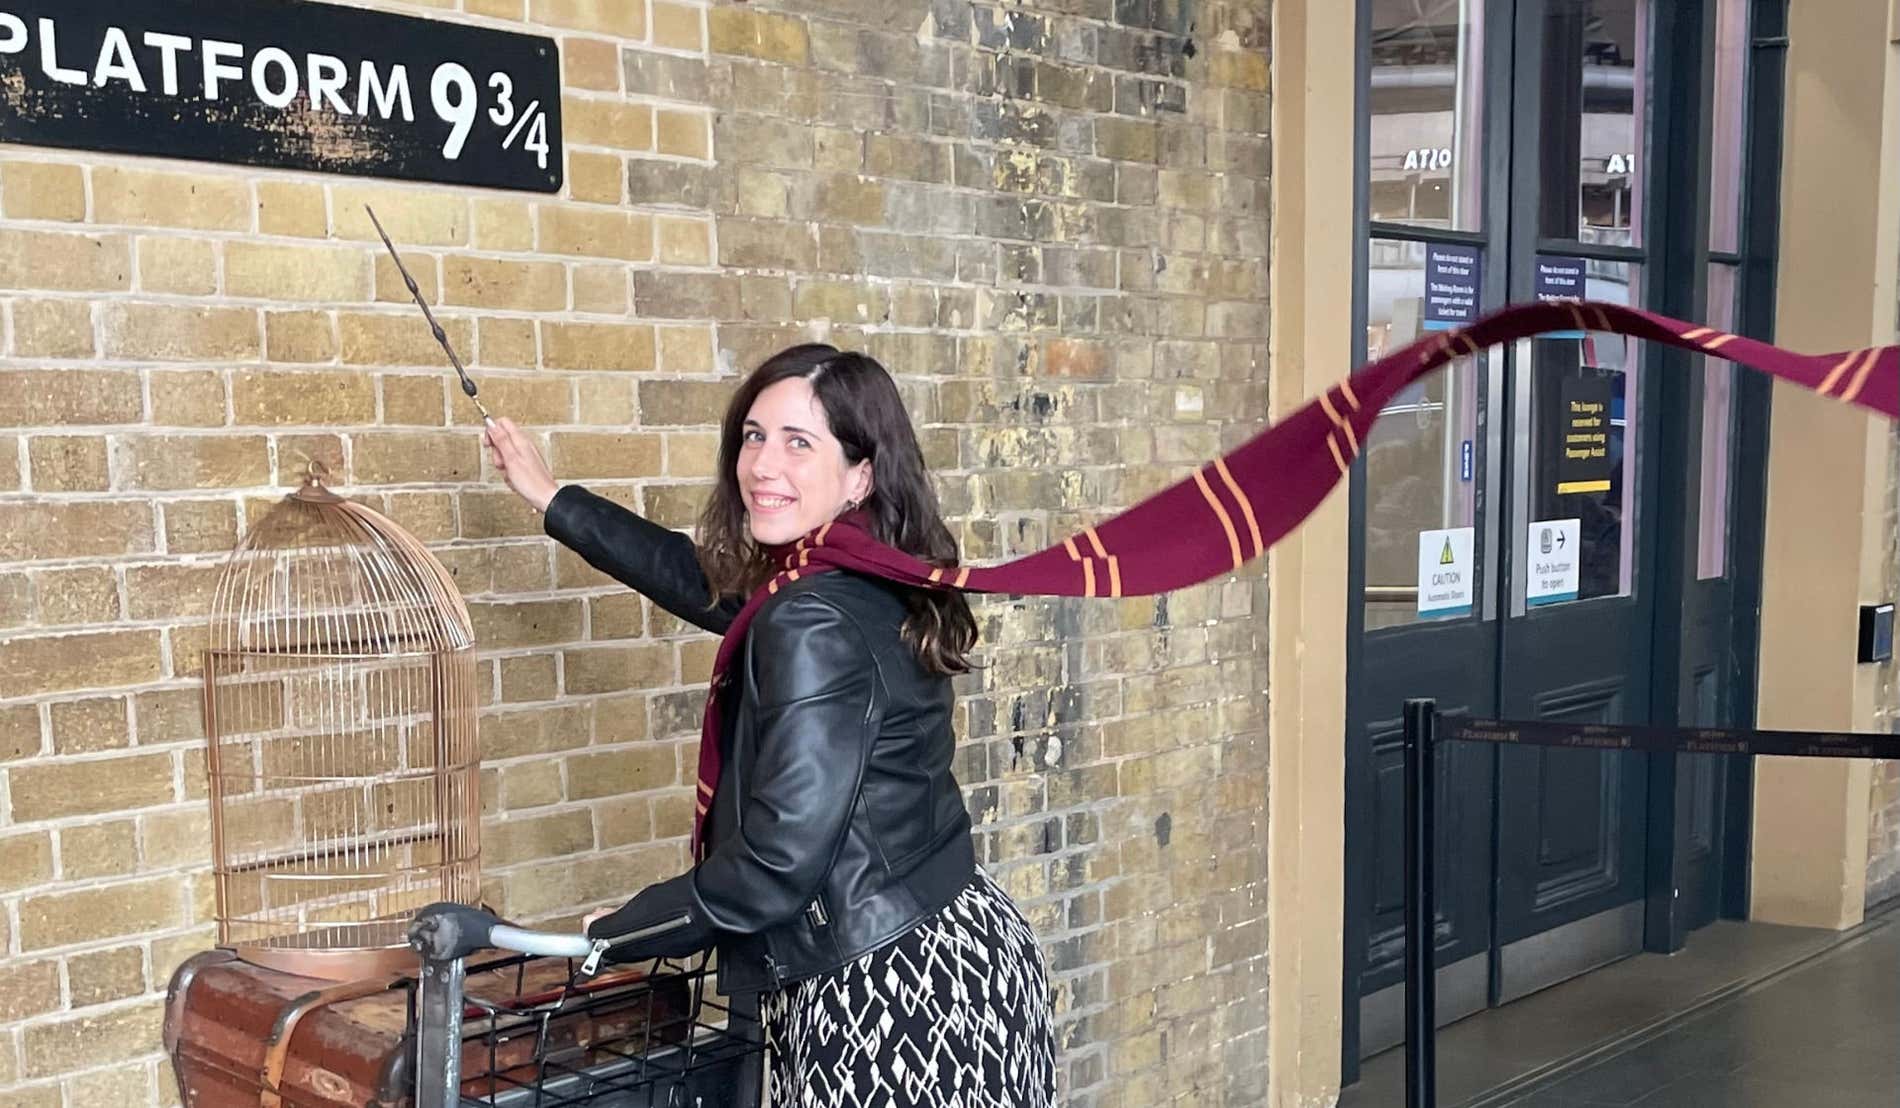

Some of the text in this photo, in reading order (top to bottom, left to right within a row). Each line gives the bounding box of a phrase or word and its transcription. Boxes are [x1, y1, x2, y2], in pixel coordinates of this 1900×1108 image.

[0, 11, 415, 122] PLATFORM
[430, 62, 478, 160] 9
[1431, 571, 1461, 586] CAUTION
